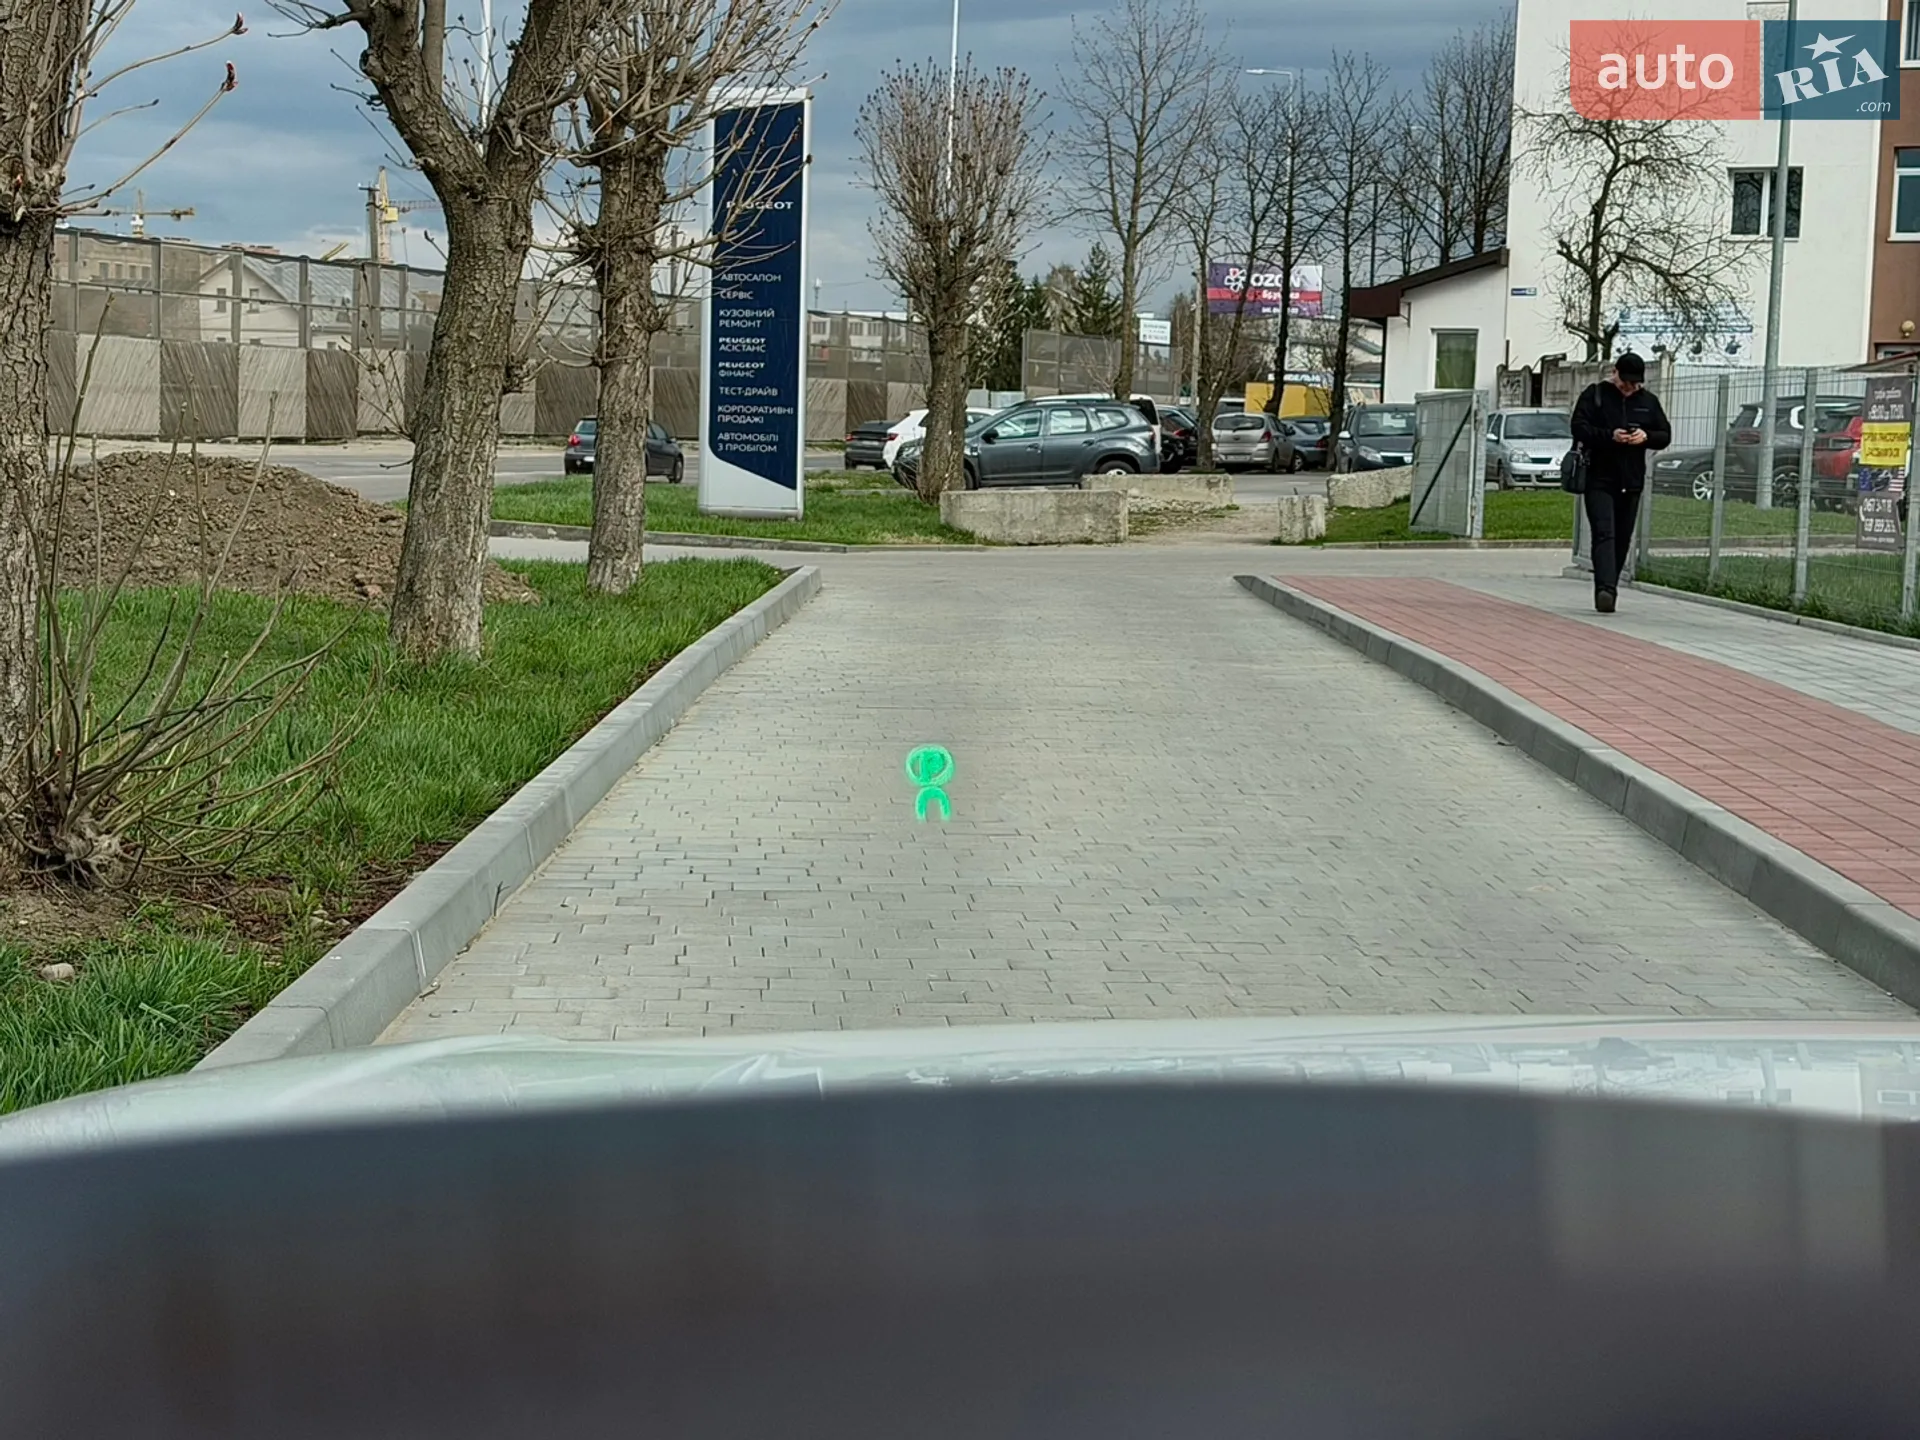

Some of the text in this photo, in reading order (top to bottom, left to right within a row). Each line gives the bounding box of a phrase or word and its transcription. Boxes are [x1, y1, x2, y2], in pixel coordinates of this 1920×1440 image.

[721, 273, 782, 282] АВТОСАЛОН
[720, 290, 754, 300] СЕРВІС
[719, 308, 775, 318] КУЗОВНИЙ
[719, 319, 762, 328] РЕМОНТ
[718, 344, 767, 353] АСІСТАНС
[718, 369, 756, 378] ФІНАНС
[719, 386, 778, 396] ТЕСТ-ДРАЙВ
[717, 404, 794, 415] КОРПОРАТИВНІ
[717, 414, 764, 424] ПРОДАЖІ
[717, 432, 779, 442] АВТОМОБІЛІ
[717, 443, 777, 453] З ПРОБІГОМ
